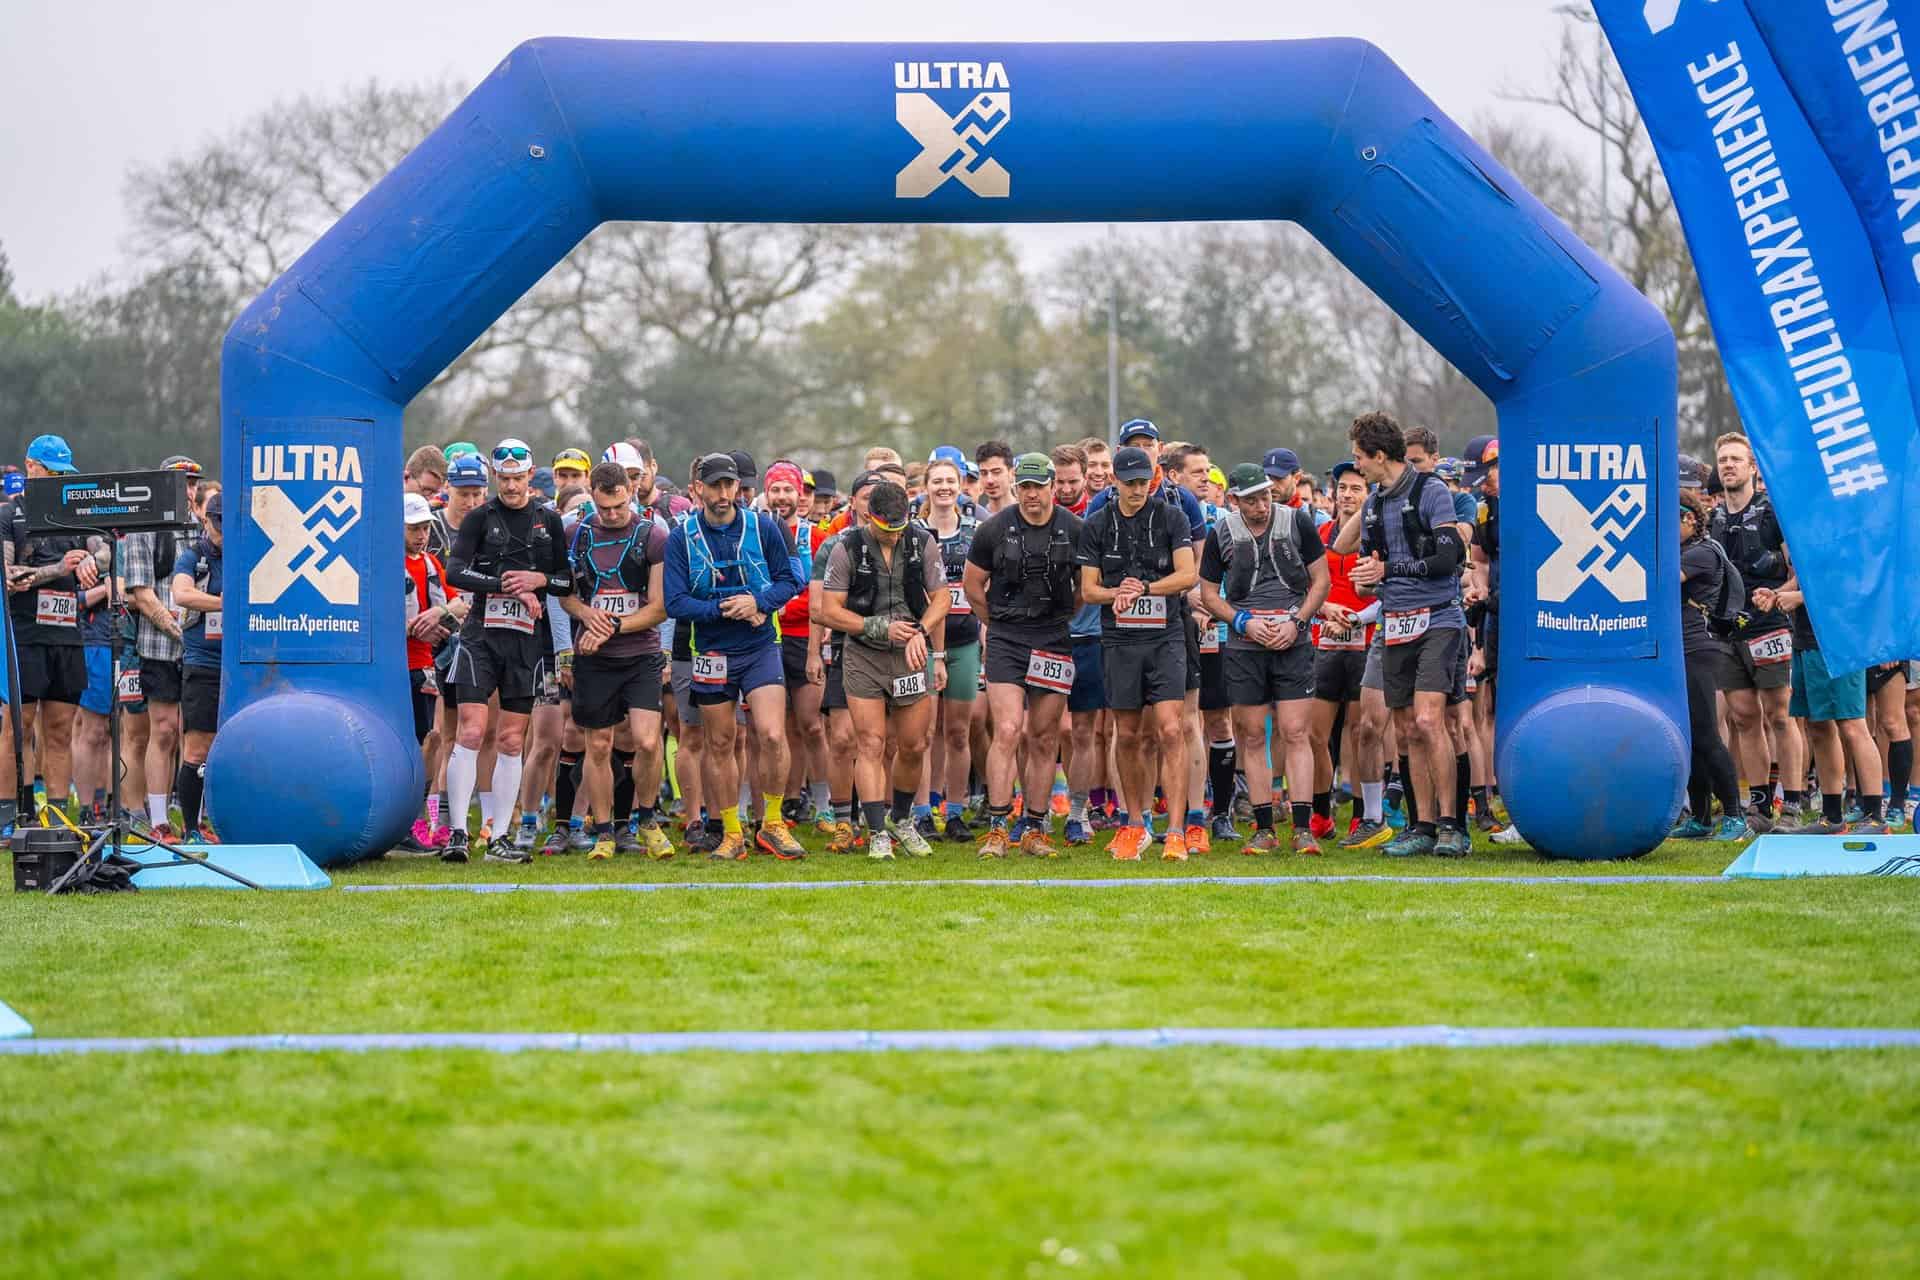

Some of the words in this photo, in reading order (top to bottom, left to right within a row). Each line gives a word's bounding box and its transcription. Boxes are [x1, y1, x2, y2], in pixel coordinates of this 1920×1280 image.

[895, 62, 1009, 88] ULTRA
[1687, 41, 1888, 497] #THEULTRAXPERIENCE
[252, 445, 363, 483] ULTRA
[1536, 444, 1646, 480] ULTRA
[66, 488, 116, 500] RESULTSBASE
[52, 598, 70, 614] 268
[502, 601, 521, 618] 541
[602, 596, 625, 613] 779
[249, 613, 360, 636] #theultraXperience
[1398, 617, 1418, 635] 567
[1536, 611, 1648, 635] #theultraXperience
[1763, 637, 1785, 657] 335
[695, 657, 712, 675] 525
[1043, 660, 1063, 680] 853
[899, 675, 919, 695] 848
